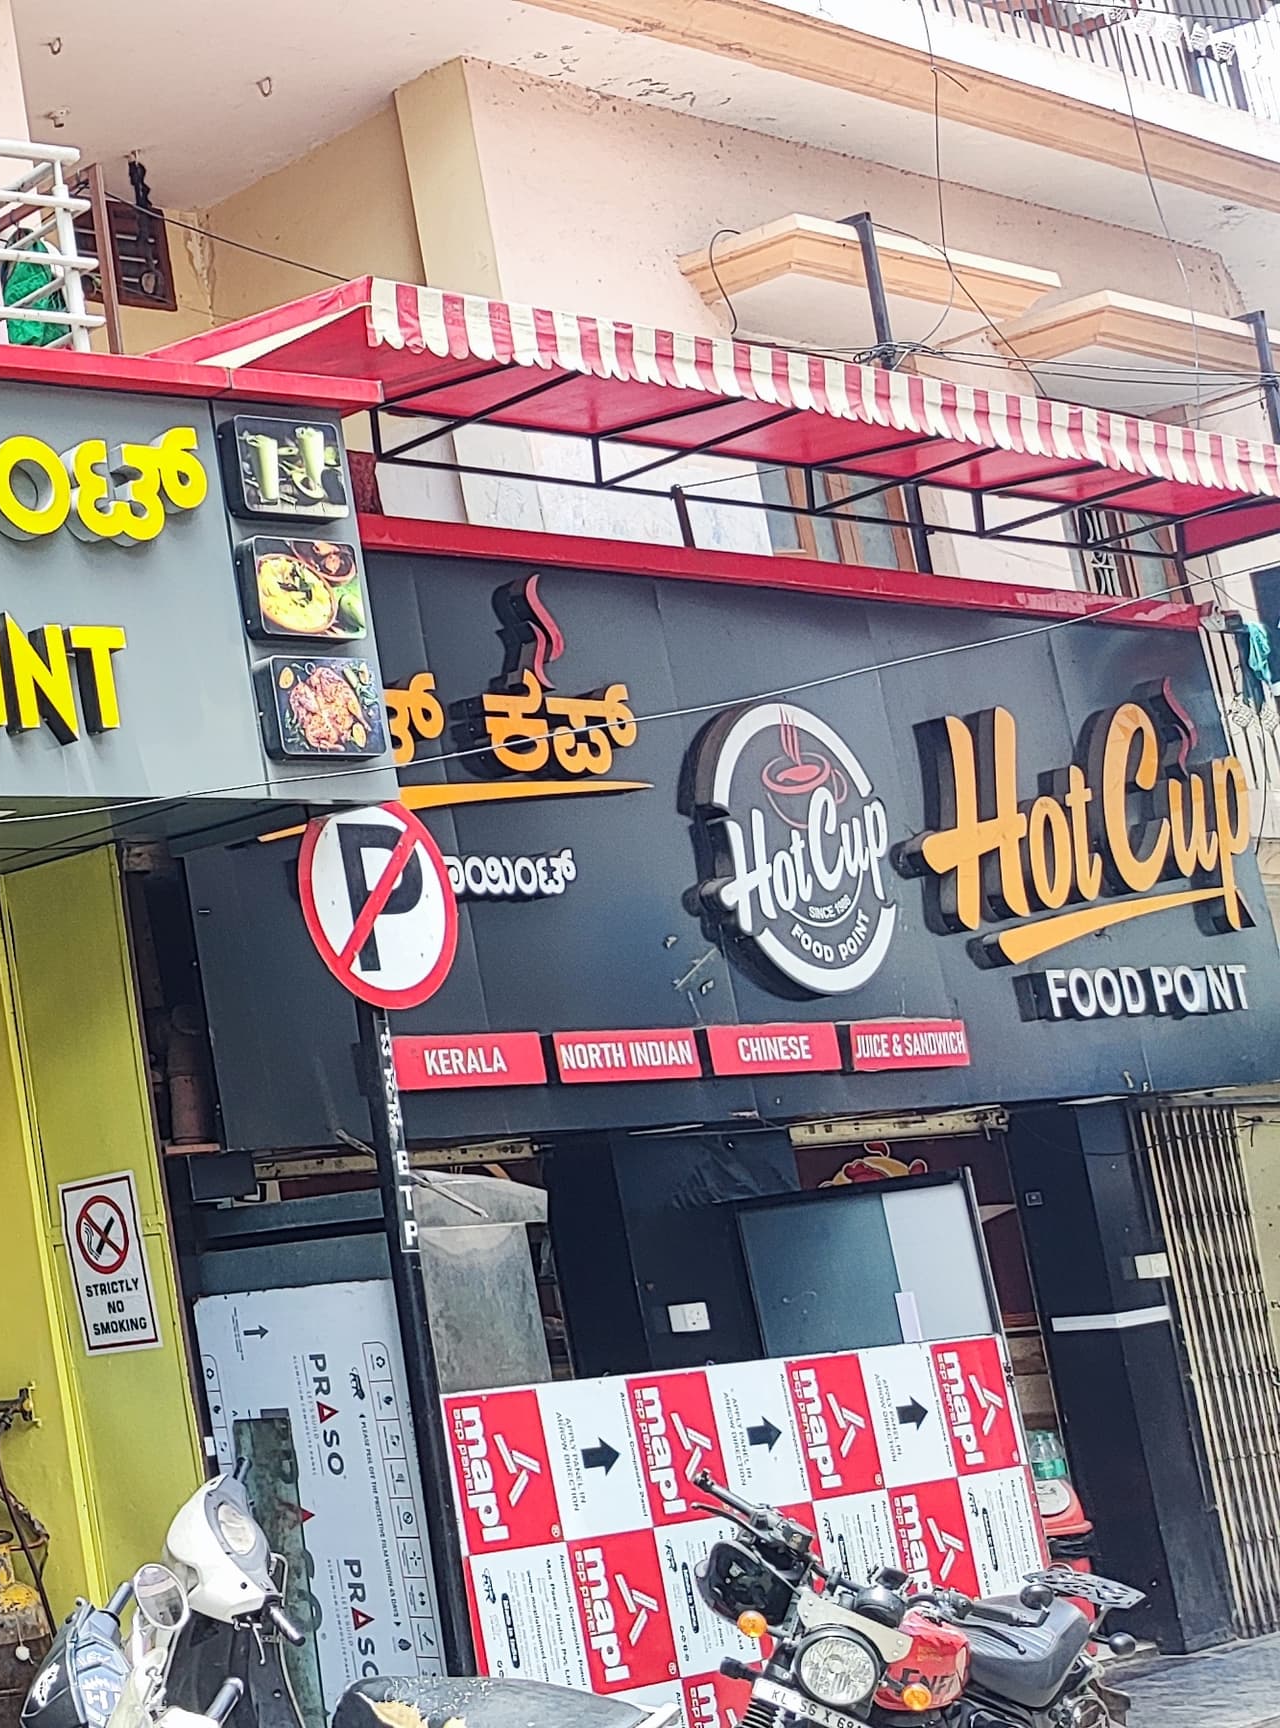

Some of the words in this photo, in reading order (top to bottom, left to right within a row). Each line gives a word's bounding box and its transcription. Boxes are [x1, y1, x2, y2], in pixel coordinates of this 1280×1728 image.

[922, 706, 1101, 931] Hot
[1101, 702, 1251, 930] Cup
[721, 808, 814, 934] Hot
[808, 787, 888, 900] Cup
[808, 905, 836, 920] SINCE
[791, 923, 836, 963] FOOD
[839, 909, 870, 962] POINT
[1046, 967, 1146, 1017] FOOD
[561, 1044, 626, 1070] NORTH
[631, 1040, 693, 1067] INDIAN
[738, 1035, 812, 1061] CHINESE
[854, 1035, 890, 1059] JUICE
[891, 1036, 903, 1055] &
[904, 1031, 967, 1055] SANDWICH
[424, 1047, 508, 1076] KERALA
[85, 1278, 139, 1298] STRICTLY
[107, 1300, 125, 1314] NO
[93, 1317, 148, 1336] SMOKING
[308, 1353, 344, 1476] PRASO
[374, 1496, 385, 1538] PROTECTIVE
[383, 1559, 394, 1587] WITHIN
[900, 1495, 933, 1594] map
[772, 1689, 788, 1705] KL
[823, 1709, 832, 1723] X
